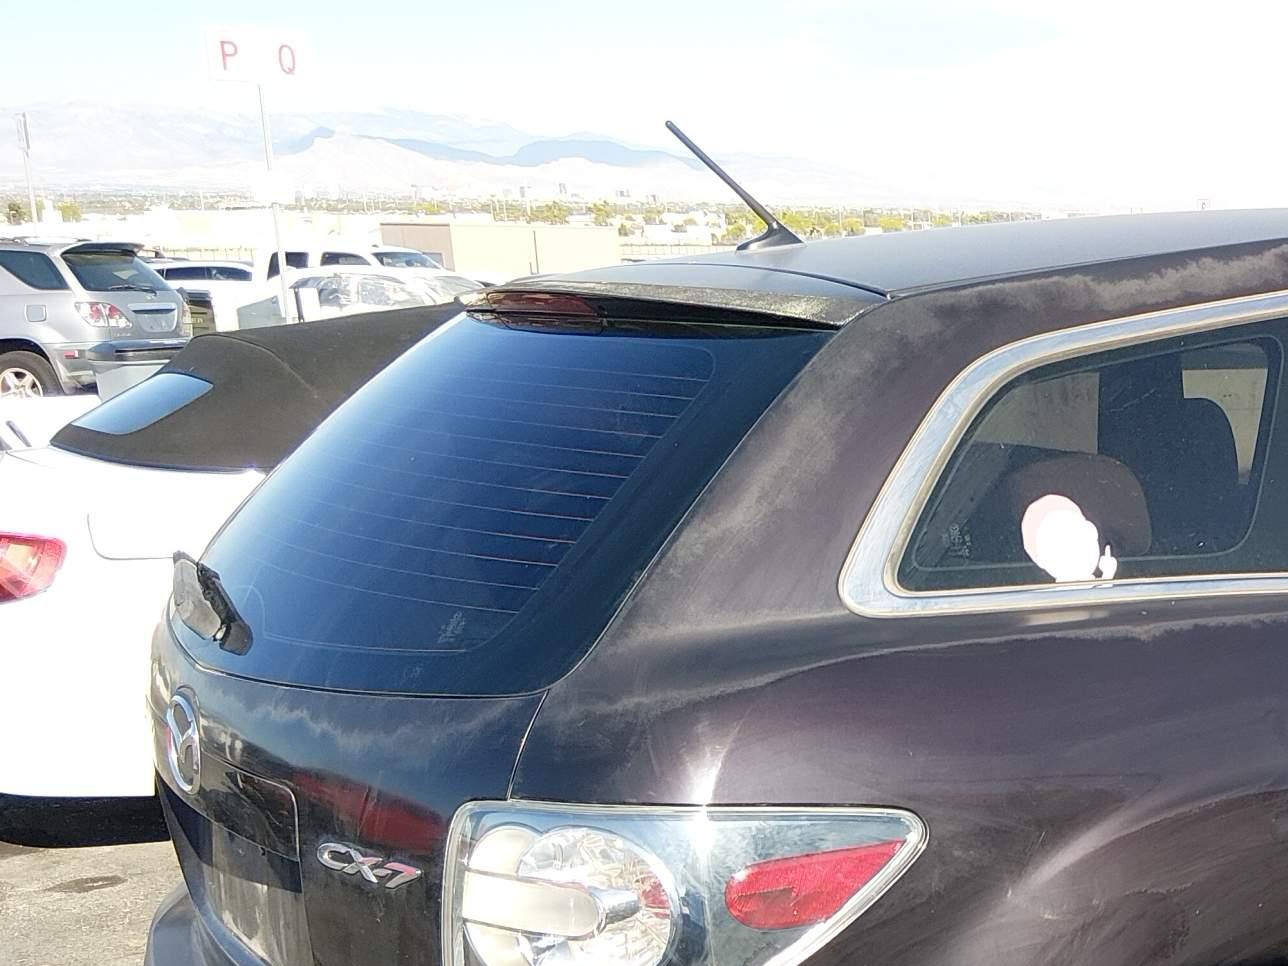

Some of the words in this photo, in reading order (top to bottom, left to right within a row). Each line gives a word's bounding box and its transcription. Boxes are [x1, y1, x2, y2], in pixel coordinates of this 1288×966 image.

[220, 40, 238, 71] P
[278, 44, 295, 75] Q
[316, 842, 422, 890] CX-7
